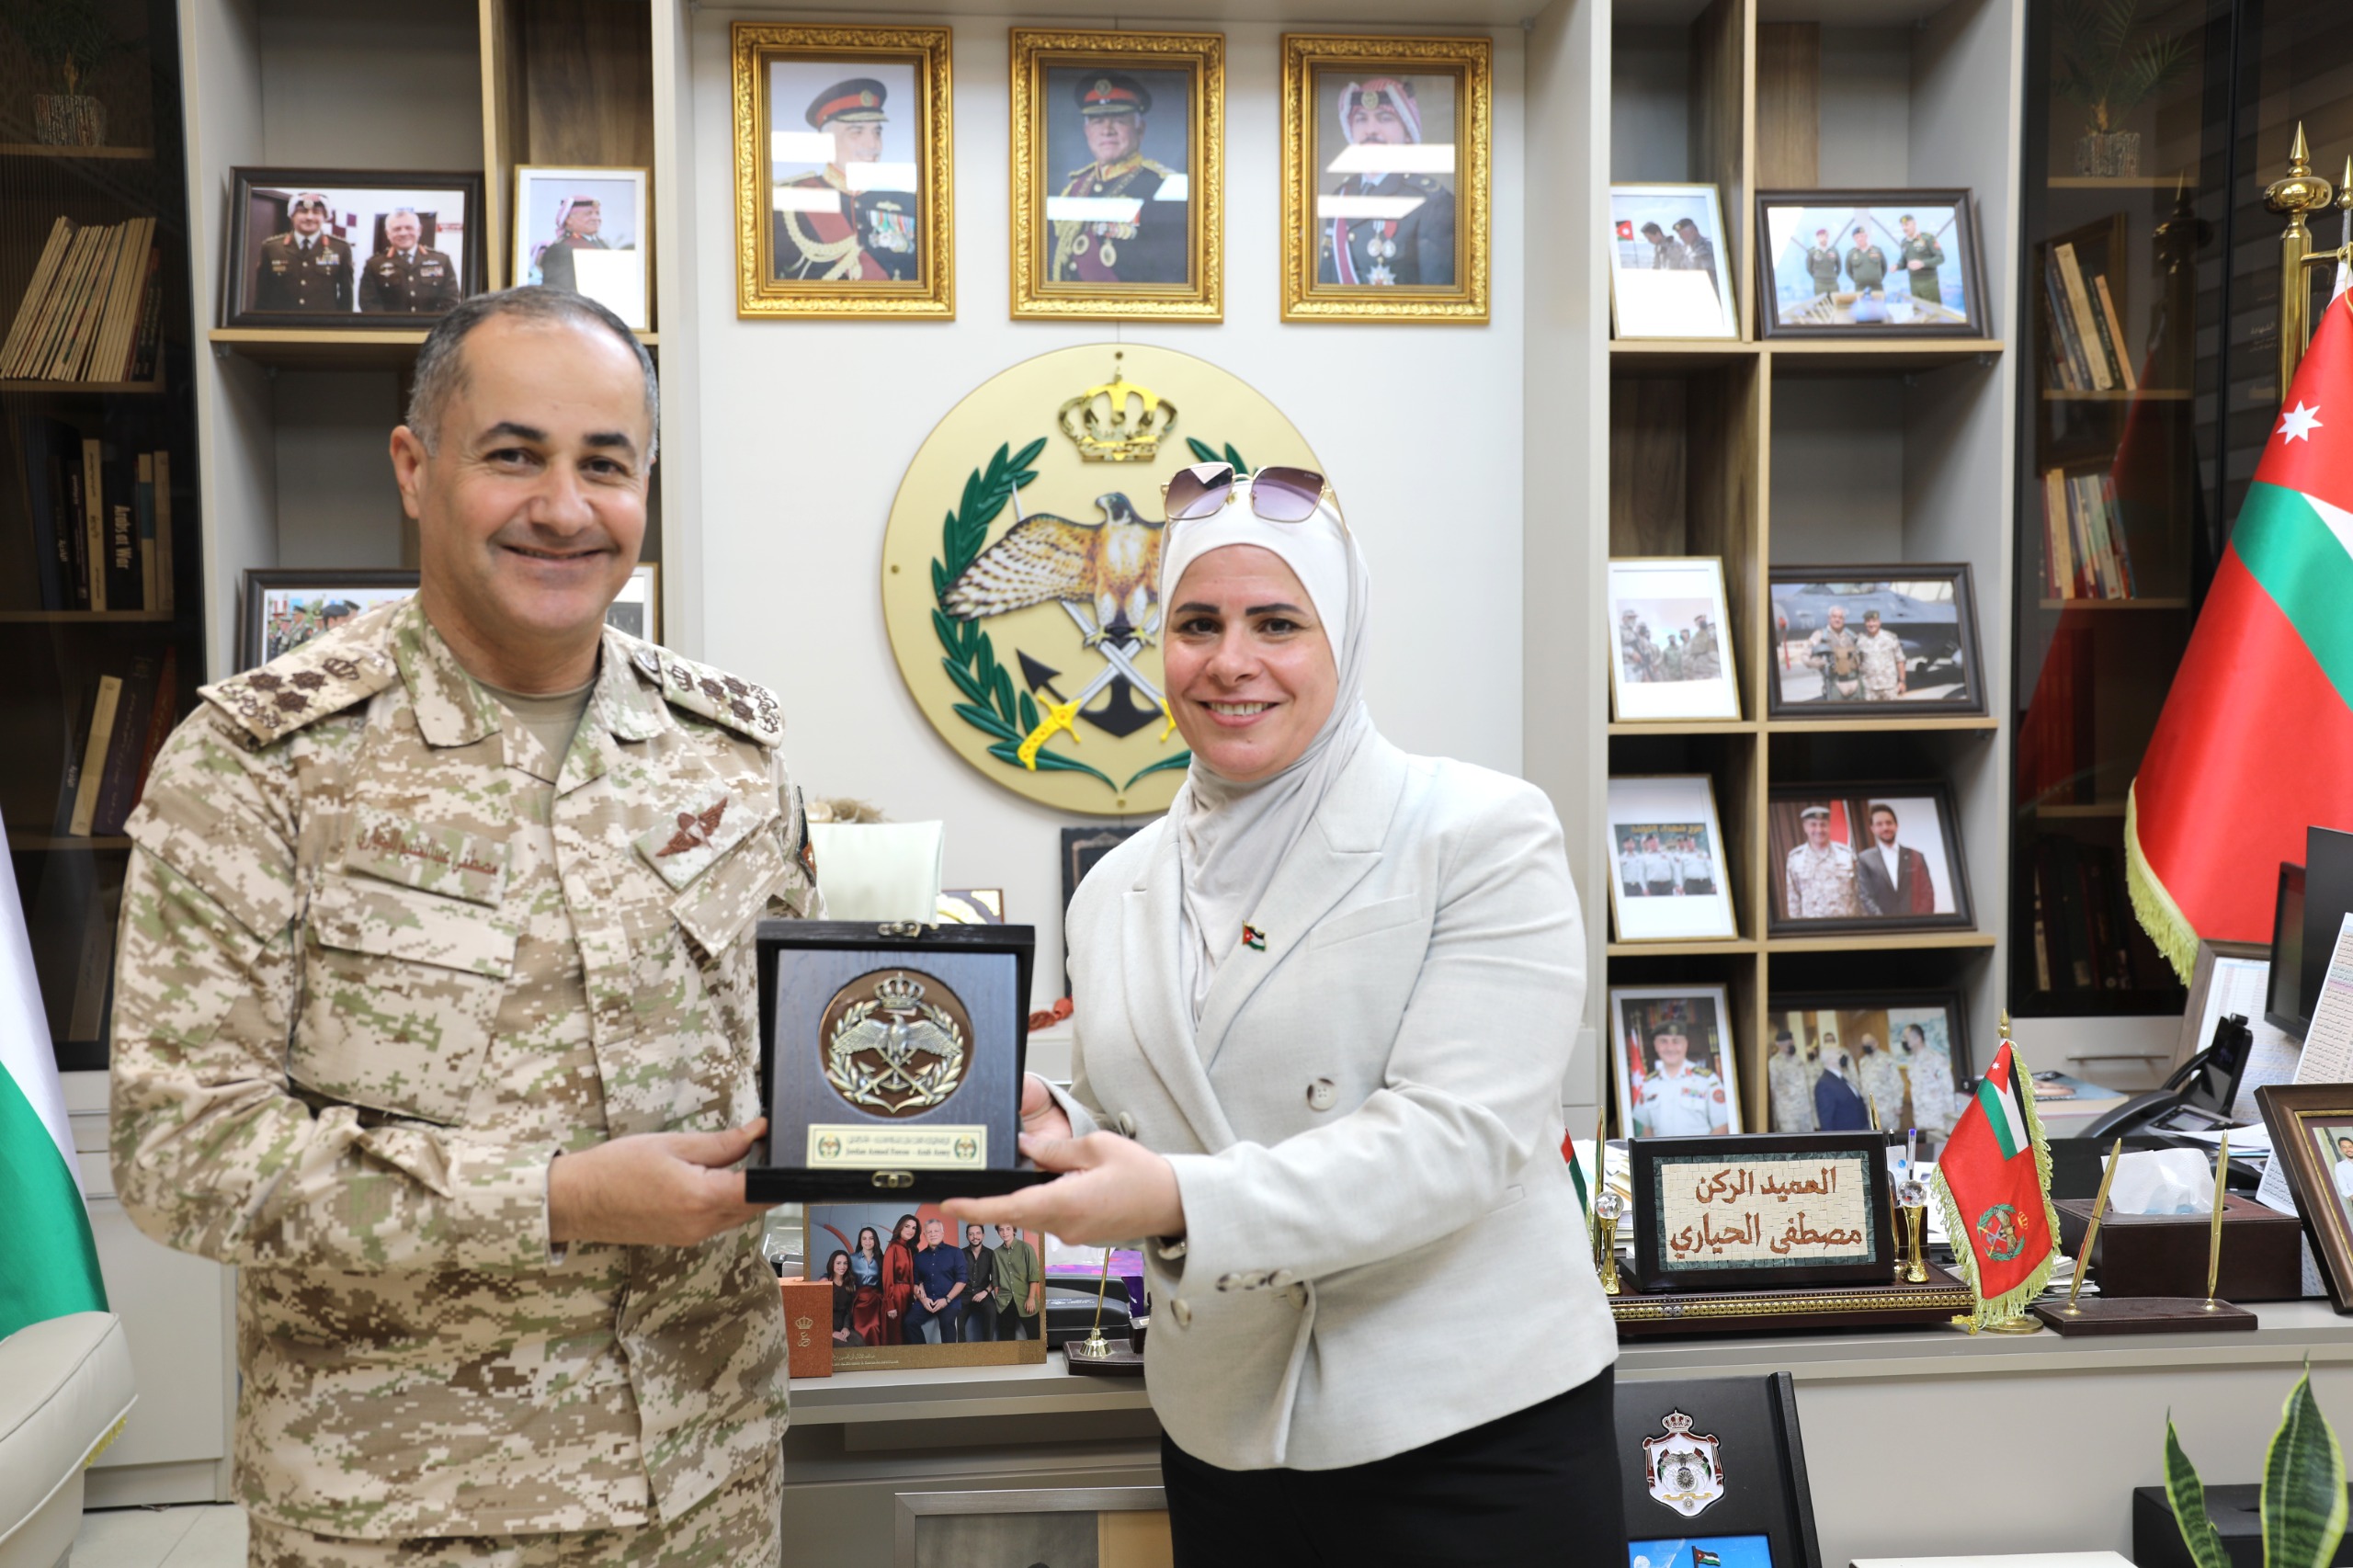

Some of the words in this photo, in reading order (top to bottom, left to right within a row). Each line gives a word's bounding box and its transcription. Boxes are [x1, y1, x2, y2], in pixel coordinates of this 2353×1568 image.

[113, 505, 132, 533] Arabs
[115, 534, 131, 545] at
[114, 547, 133, 570] War
[1695, 1168, 1754, 1204] الركن
[1760, 1165, 1836, 1202] العميد
[1670, 1211, 1761, 1259] الحياري
[1769, 1210, 1862, 1254] مصطفى
